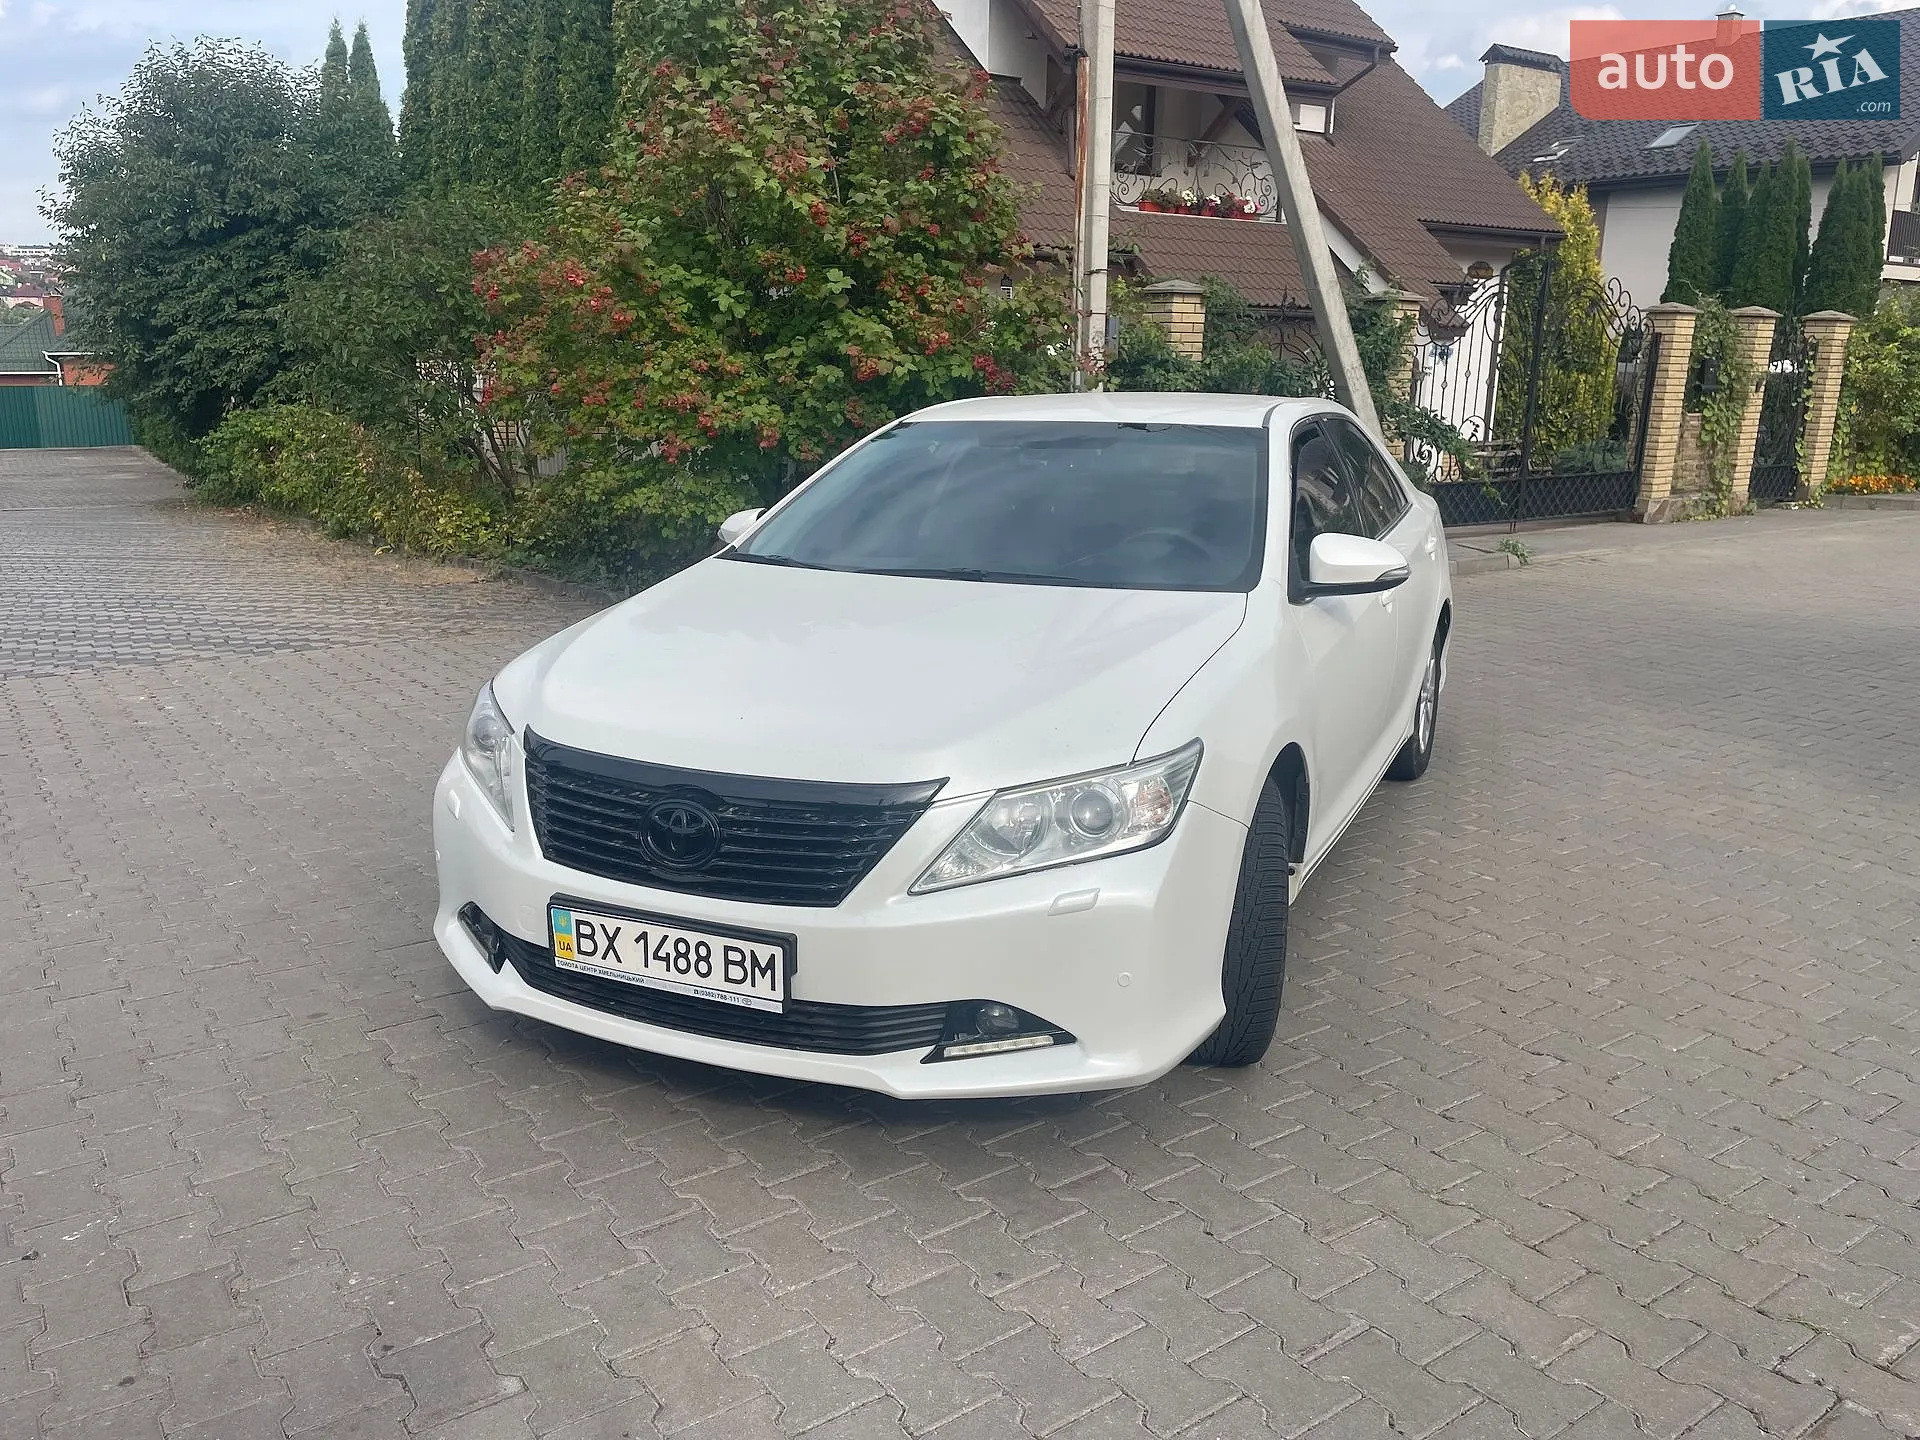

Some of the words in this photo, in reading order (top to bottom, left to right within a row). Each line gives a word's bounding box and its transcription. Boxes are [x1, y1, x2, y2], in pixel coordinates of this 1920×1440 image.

[558, 941, 573, 953] UA
[575, 919, 622, 964] BX
[634, 931, 712, 978] 1488
[723, 945, 776, 992] BM
